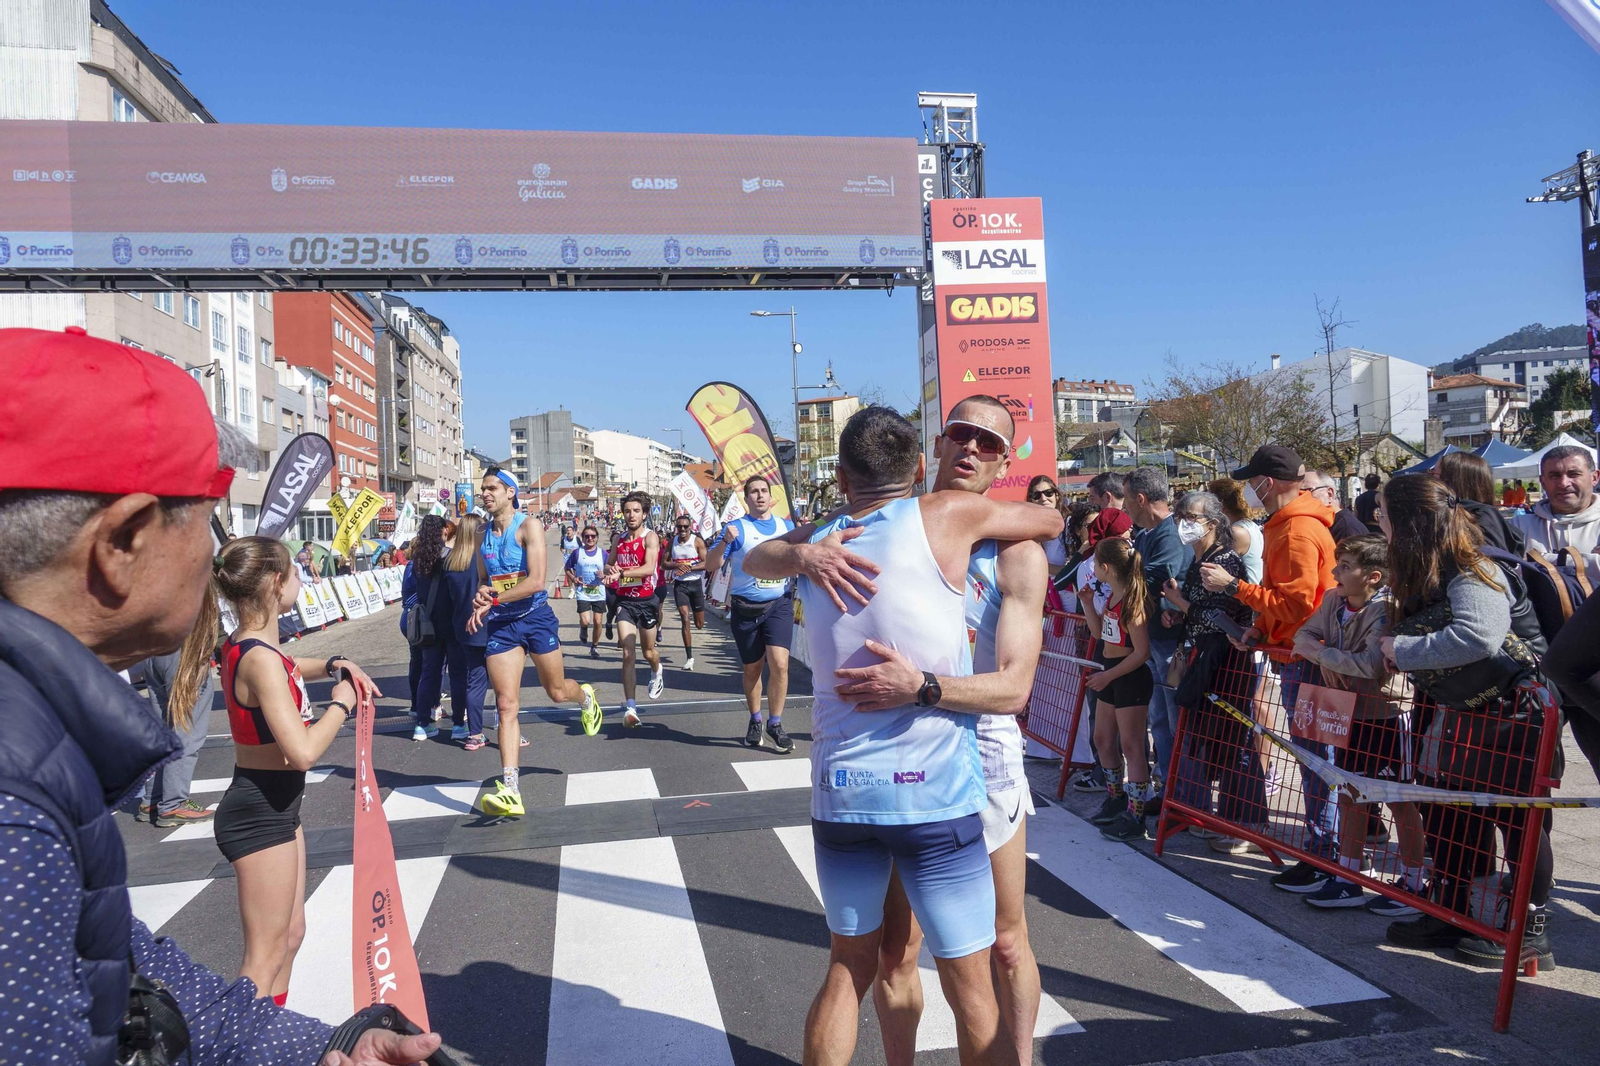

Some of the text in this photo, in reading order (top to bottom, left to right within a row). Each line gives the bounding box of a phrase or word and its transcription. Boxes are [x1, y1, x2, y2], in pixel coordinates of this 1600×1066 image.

[160, 172, 207, 184] CEAMSA
[409, 175, 455, 184] ELECPOR
[517, 178, 568, 187] eurobanan
[631, 177, 678, 190] GADIS
[762, 178, 785, 188] GIA
[518, 186, 567, 202] Galicia
[16, 245, 73, 256] O Porriño
[138, 246, 193, 257] O Porriño
[289, 237, 429, 265] 00:33:46
[477, 246, 527, 257] O Porriño
[583, 246, 631, 257] O Porriño
[685, 246, 732, 257] O Porriño
[784, 246, 829, 257] O Porriño
[879, 246, 923, 257] O Porriño
[965, 248, 1037, 269] LASAL
[950, 295, 1036, 321] GADIS
[970, 338, 1015, 347] RODOSA
[978, 366, 1031, 376] ELECPOR
[311, 455, 328, 478] cocinas
[270, 452, 322, 515] LASAL
[344, 494, 375, 535] ELECPOR
[860, 778, 891, 786] GALICIA
[893, 771, 926, 784] NON
[385, 887, 394, 925] oporriño
